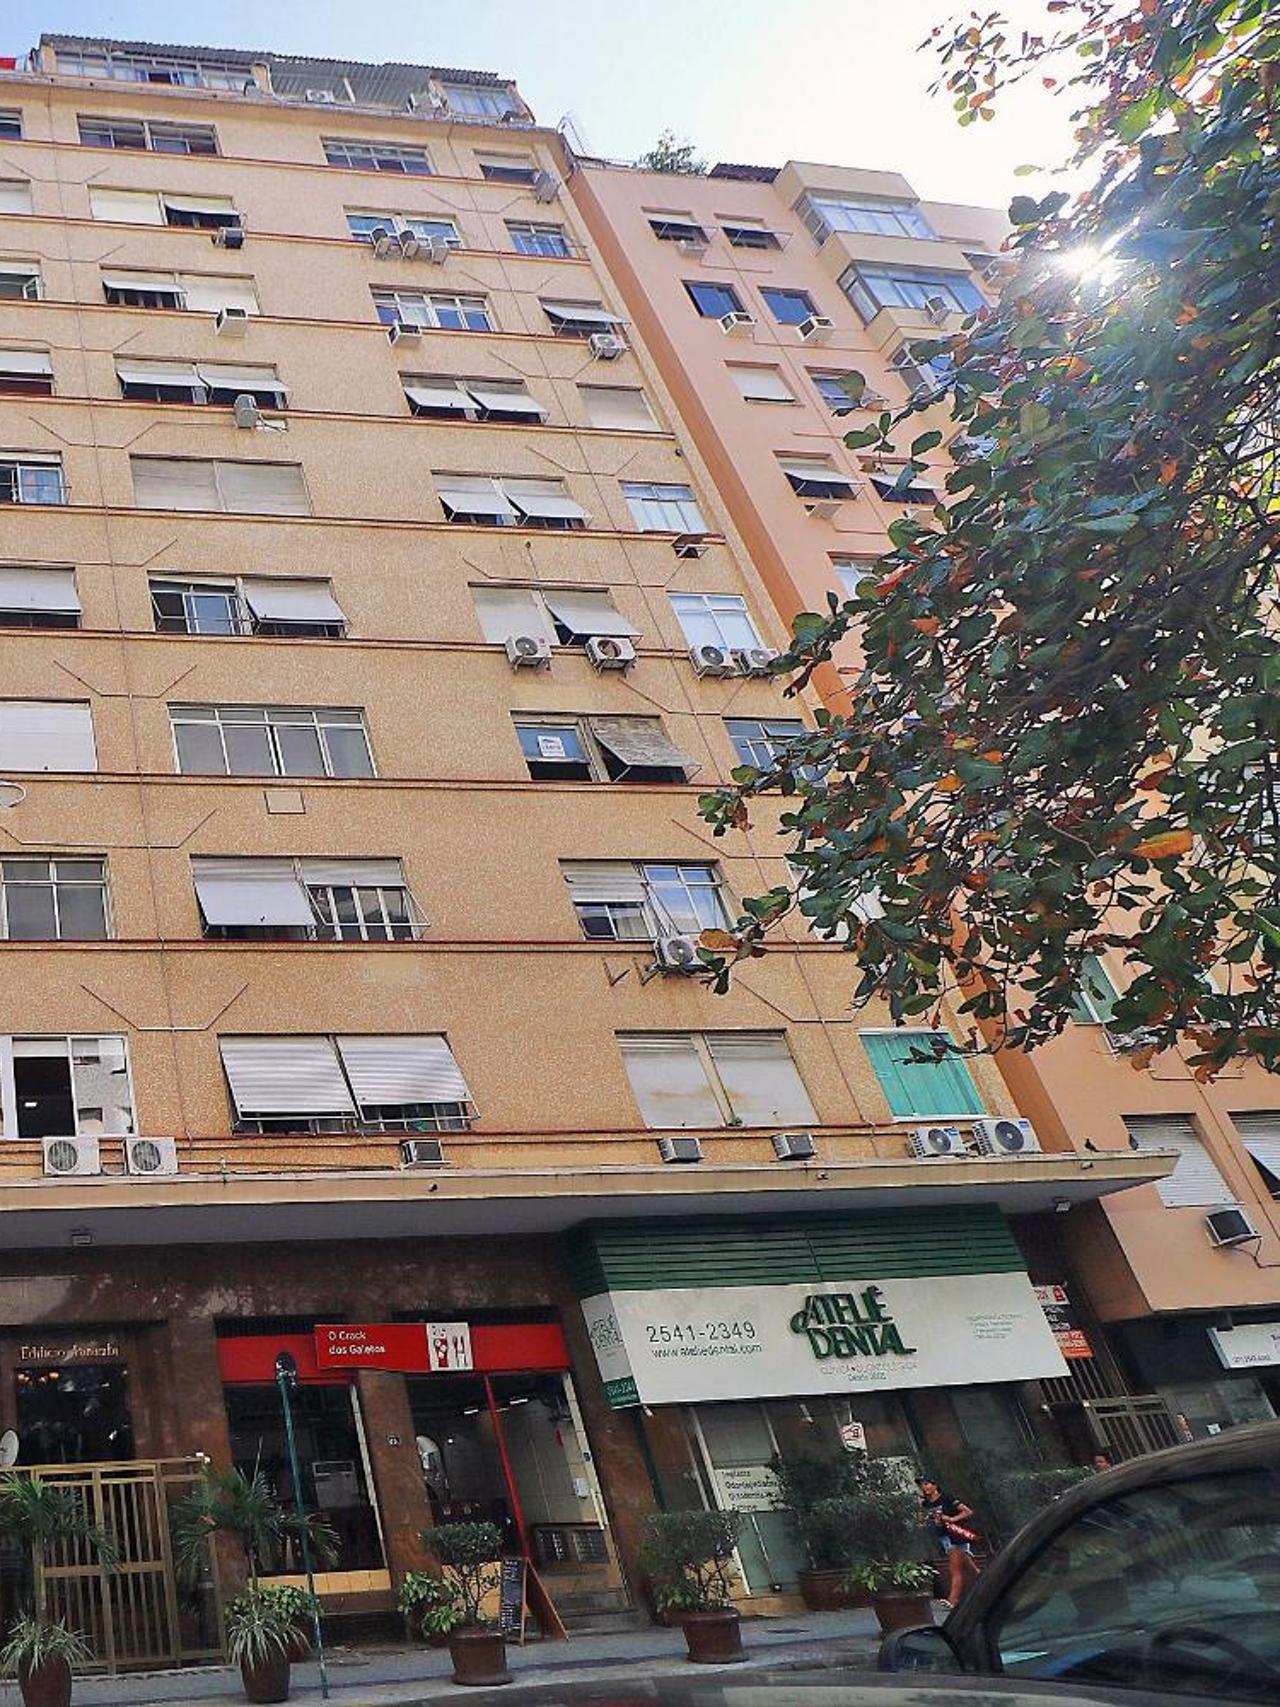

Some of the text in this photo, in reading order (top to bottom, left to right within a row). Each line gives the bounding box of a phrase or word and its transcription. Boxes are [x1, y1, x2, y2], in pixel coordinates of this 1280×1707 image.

[328, 1331, 367, 1341] O Crack
[646, 1321, 756, 1343] 2541-2349
[328, 1344, 347, 1355] dos
[806, 1323, 917, 1360] DENTAL
